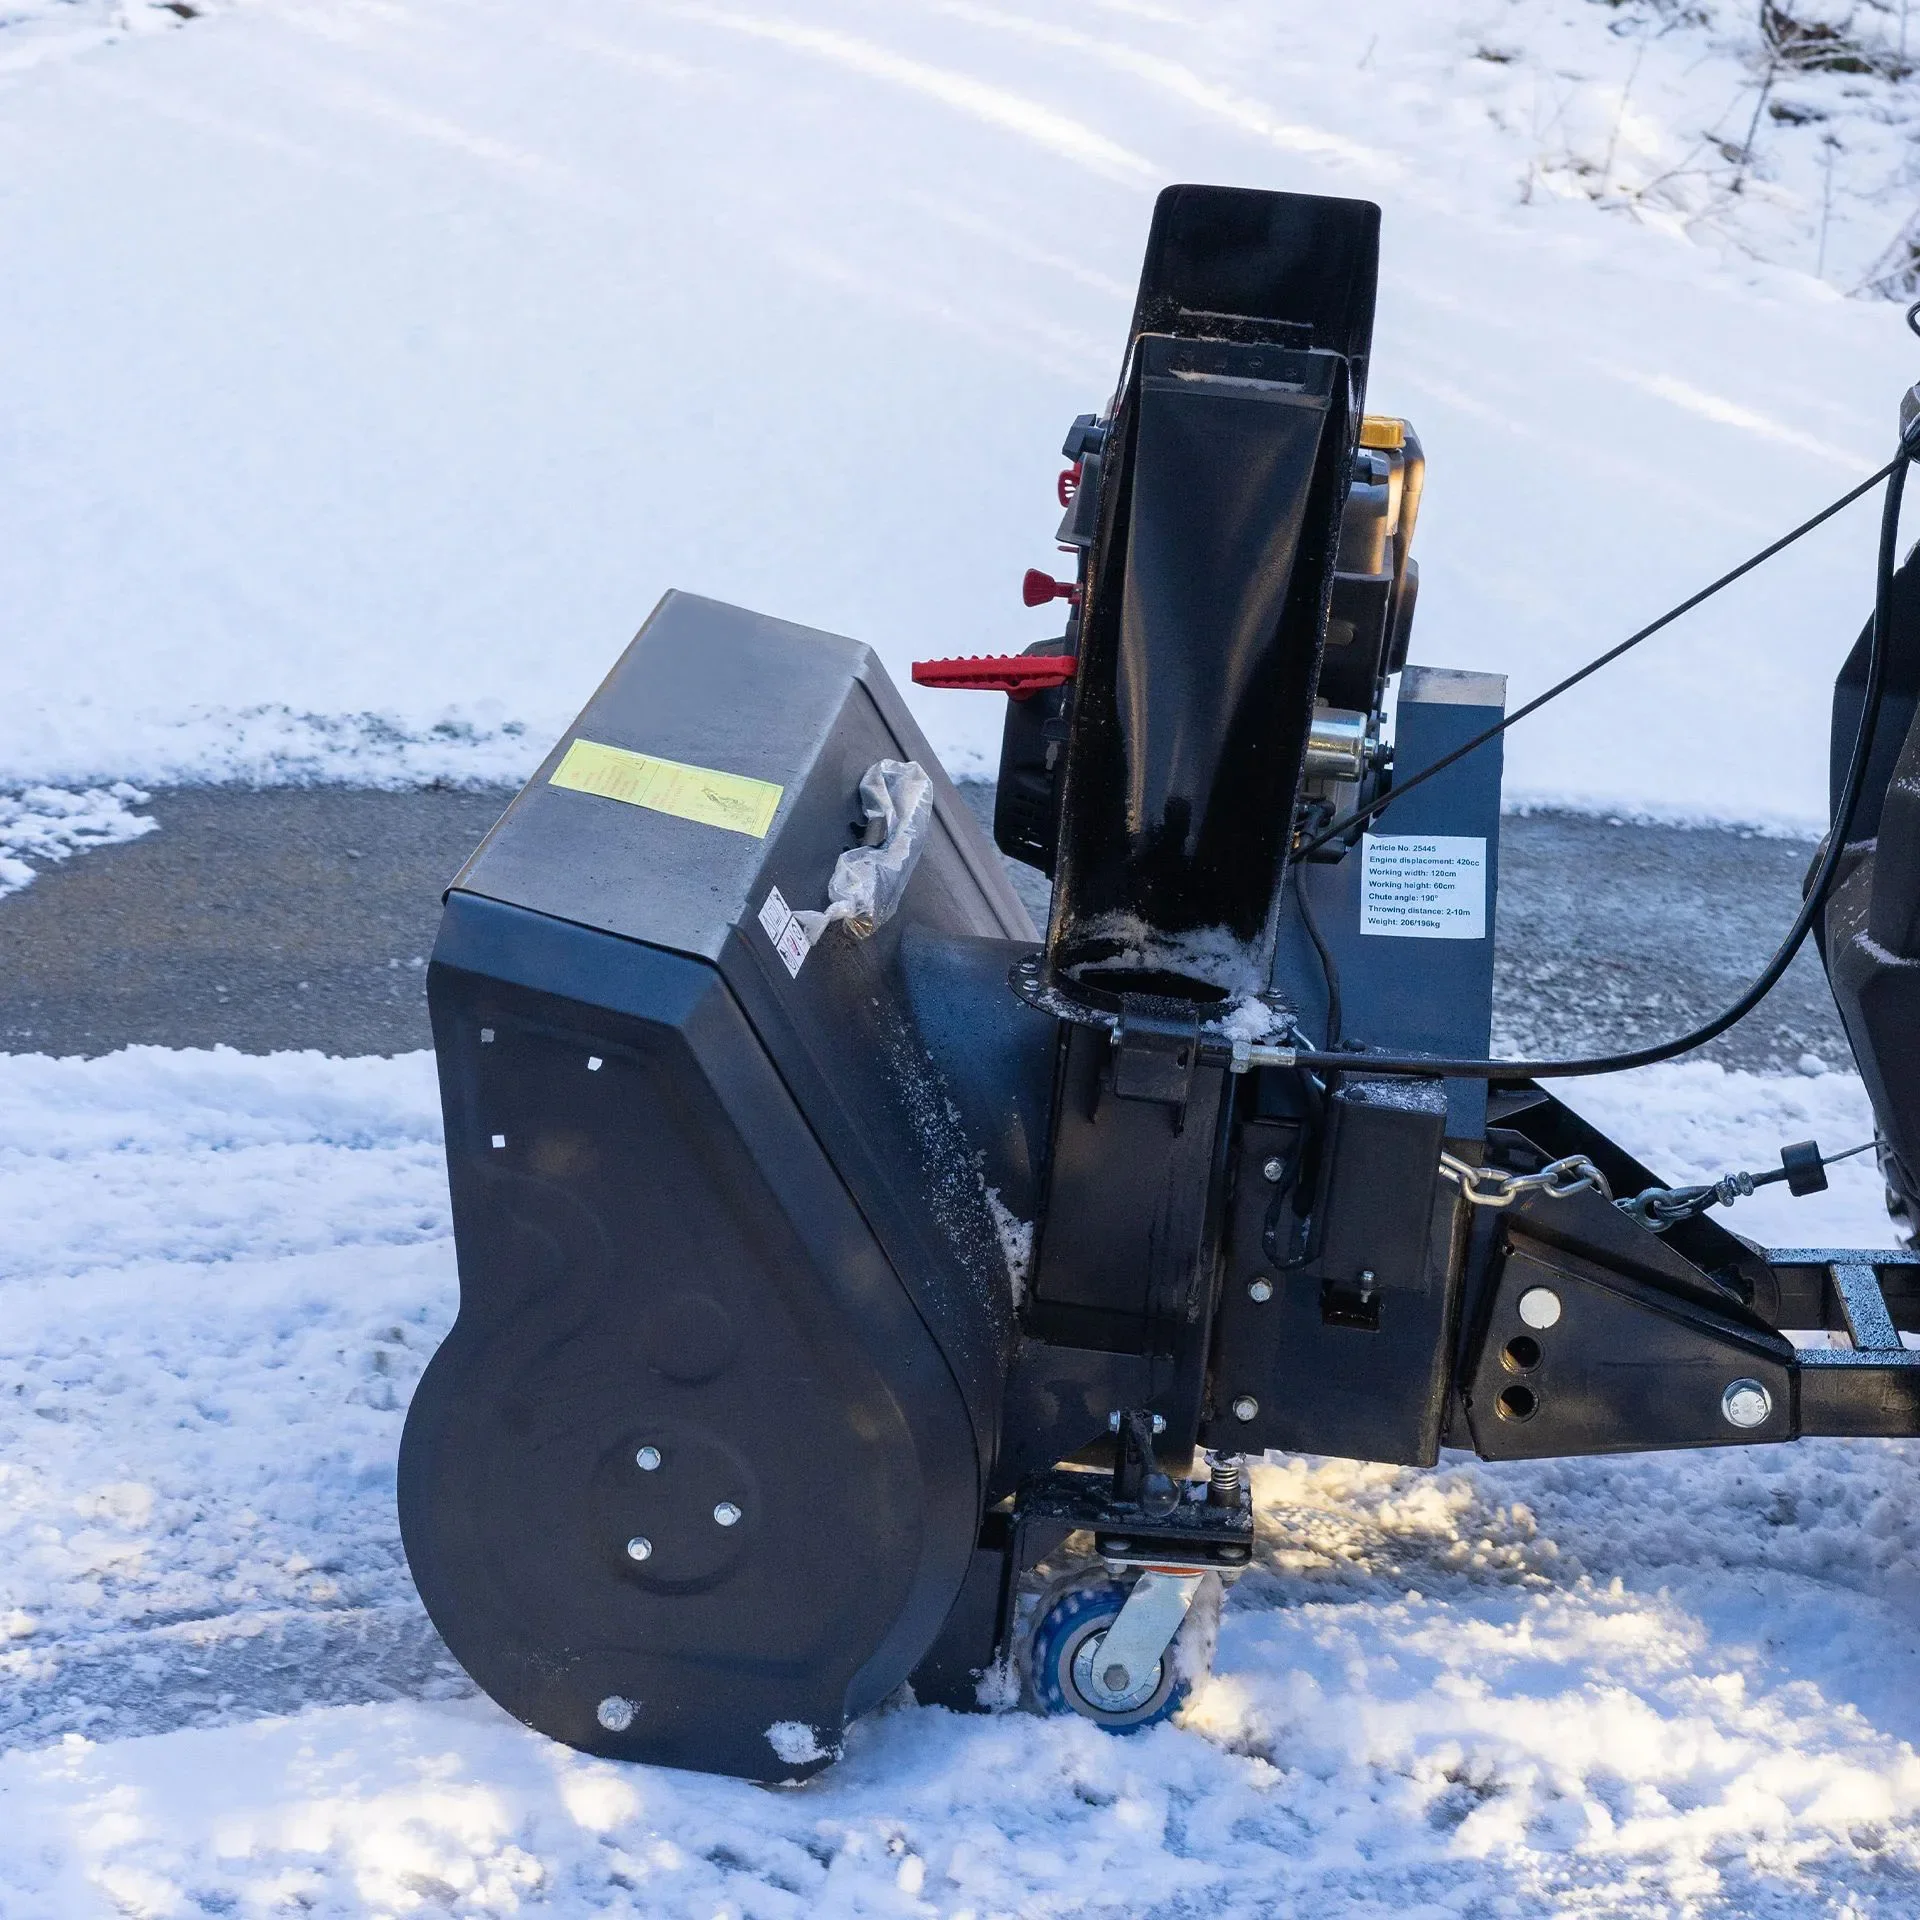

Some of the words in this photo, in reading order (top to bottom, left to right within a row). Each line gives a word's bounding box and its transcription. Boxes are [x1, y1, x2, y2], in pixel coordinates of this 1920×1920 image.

[1400, 857, 1454, 865] displacement:
[1456, 858, 1479, 866] 420cc
[1369, 868, 1402, 877] Working
[1369, 881, 1402, 889] Working
[1405, 882, 1431, 890] height:
[1395, 894, 1419, 902] angle:
[1369, 905, 1405, 914] Throwing
[1408, 907, 1444, 915] distance:
[1368, 917, 1398, 926] Weight:
